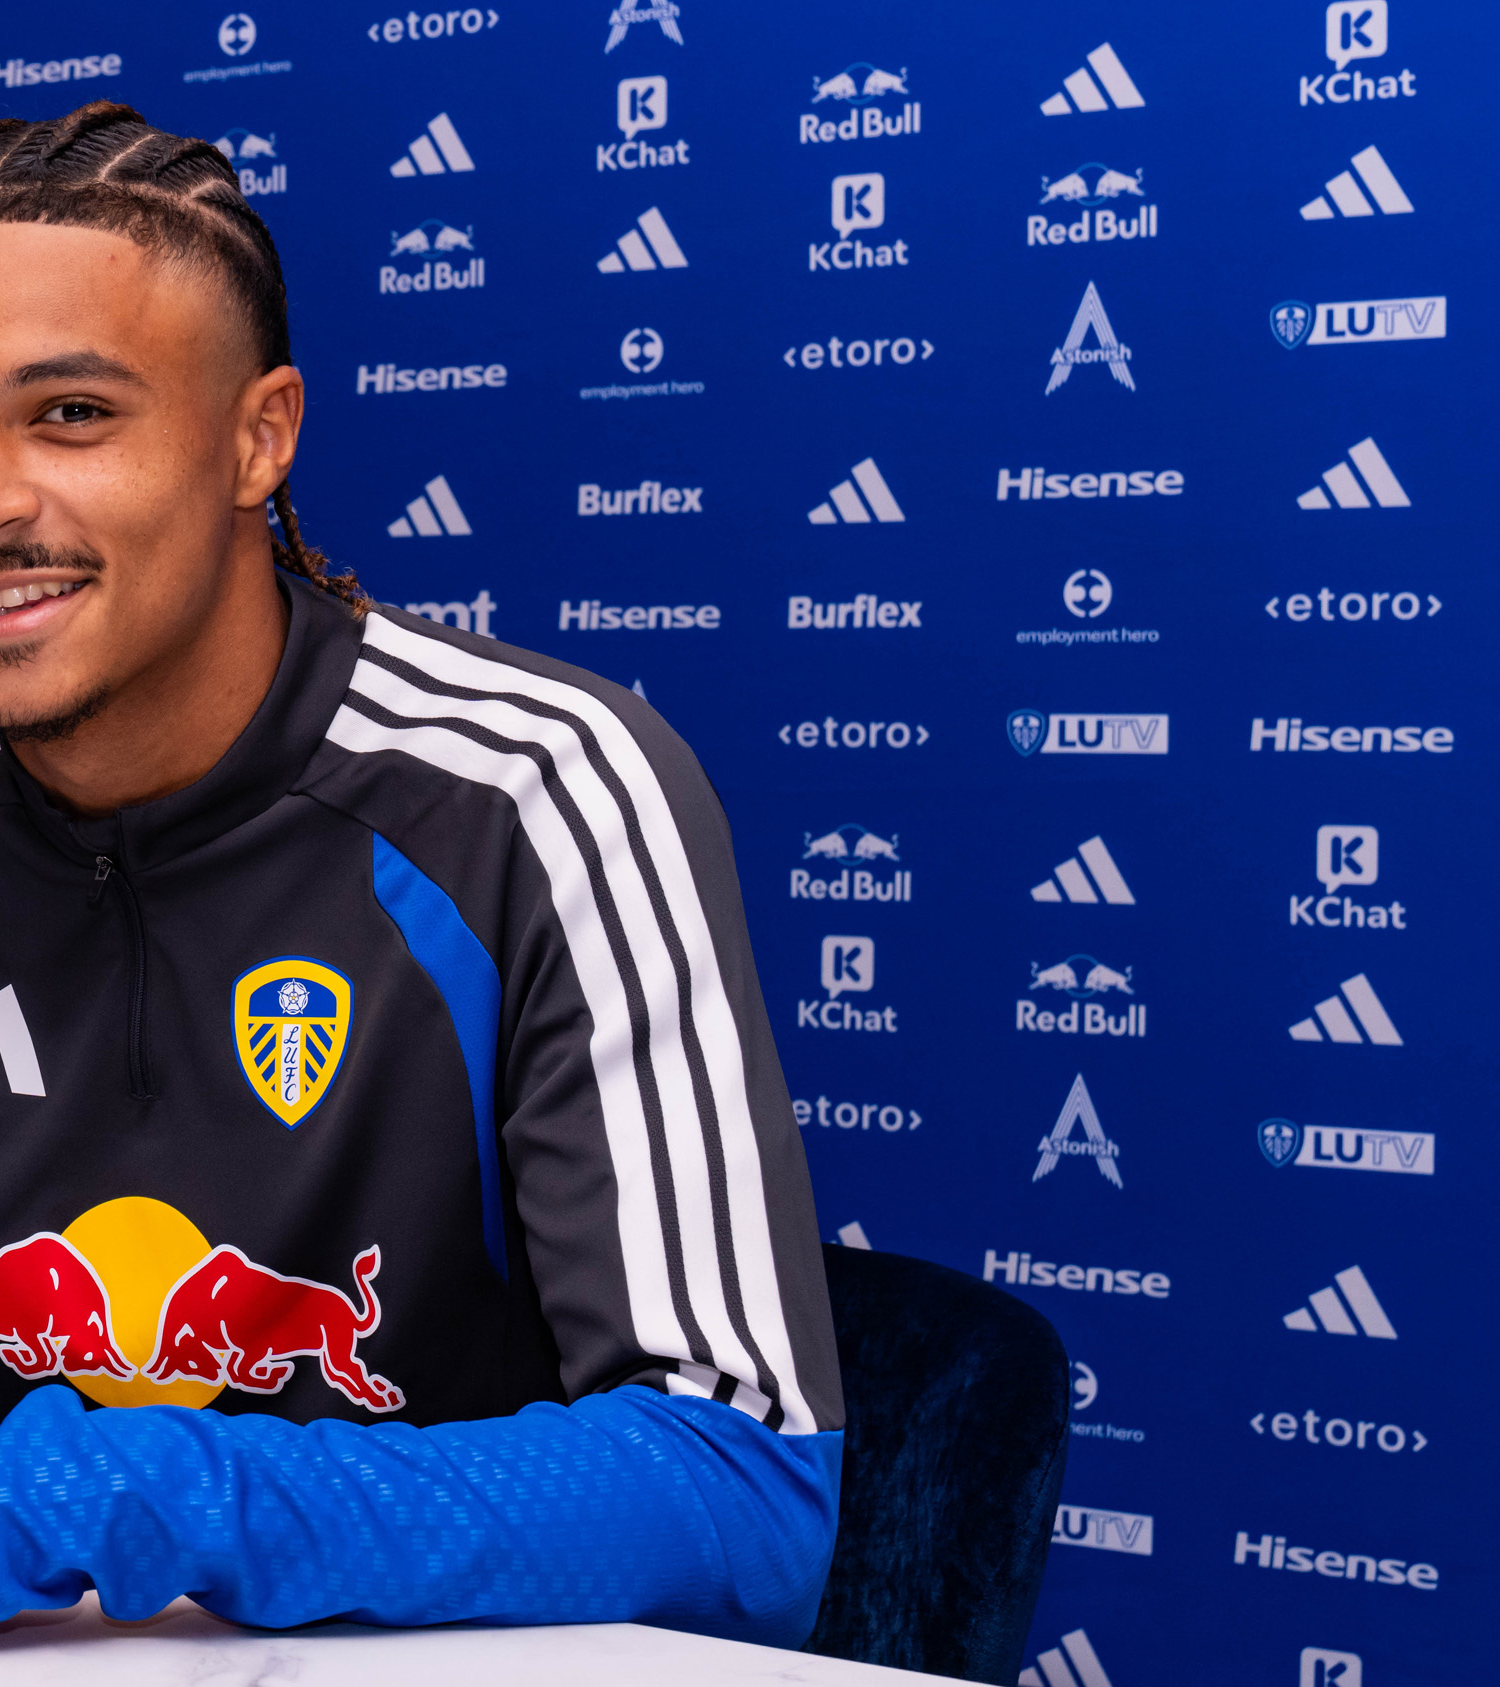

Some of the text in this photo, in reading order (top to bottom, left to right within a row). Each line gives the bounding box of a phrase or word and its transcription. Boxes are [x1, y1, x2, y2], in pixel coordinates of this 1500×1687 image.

[1299, 68, 1417, 107] KChat
[799, 102, 921, 145] Red Bull
[596, 139, 690, 172] KChat
[1027, 204, 1158, 246] Red Bull
[809, 239, 909, 272] KChat
[379, 258, 485, 294] Red Bull
[1324, 301, 1438, 338] LUTV
[1049, 340, 1133, 366] Astonish
[356, 363, 508, 395] Hisense
[579, 381, 705, 400] employment hero
[577, 480, 703, 516] Burflex
[996, 467, 1185, 501] Hisense
[382, 590, 497, 639] mt
[559, 600, 721, 631] Hisense
[787, 593, 922, 630] Burflex
[1015, 627, 1160, 647] employment hero
[1056, 717, 1162, 749] LUTV
[1250, 718, 1454, 753] Hisense
[790, 869, 912, 902] Red Bull
[1289, 895, 1406, 930] KChat
[798, 1000, 897, 1033] KChat
[1016, 999, 1147, 1037] Red Bull
[283, 1025, 300, 1102] LUFC
[1036, 1133, 1121, 1159] Astonish
[1311, 1127, 1425, 1169] LUTV
[983, 1249, 1171, 1298] Hisense
[1234, 1531, 1439, 1590] Hisense
